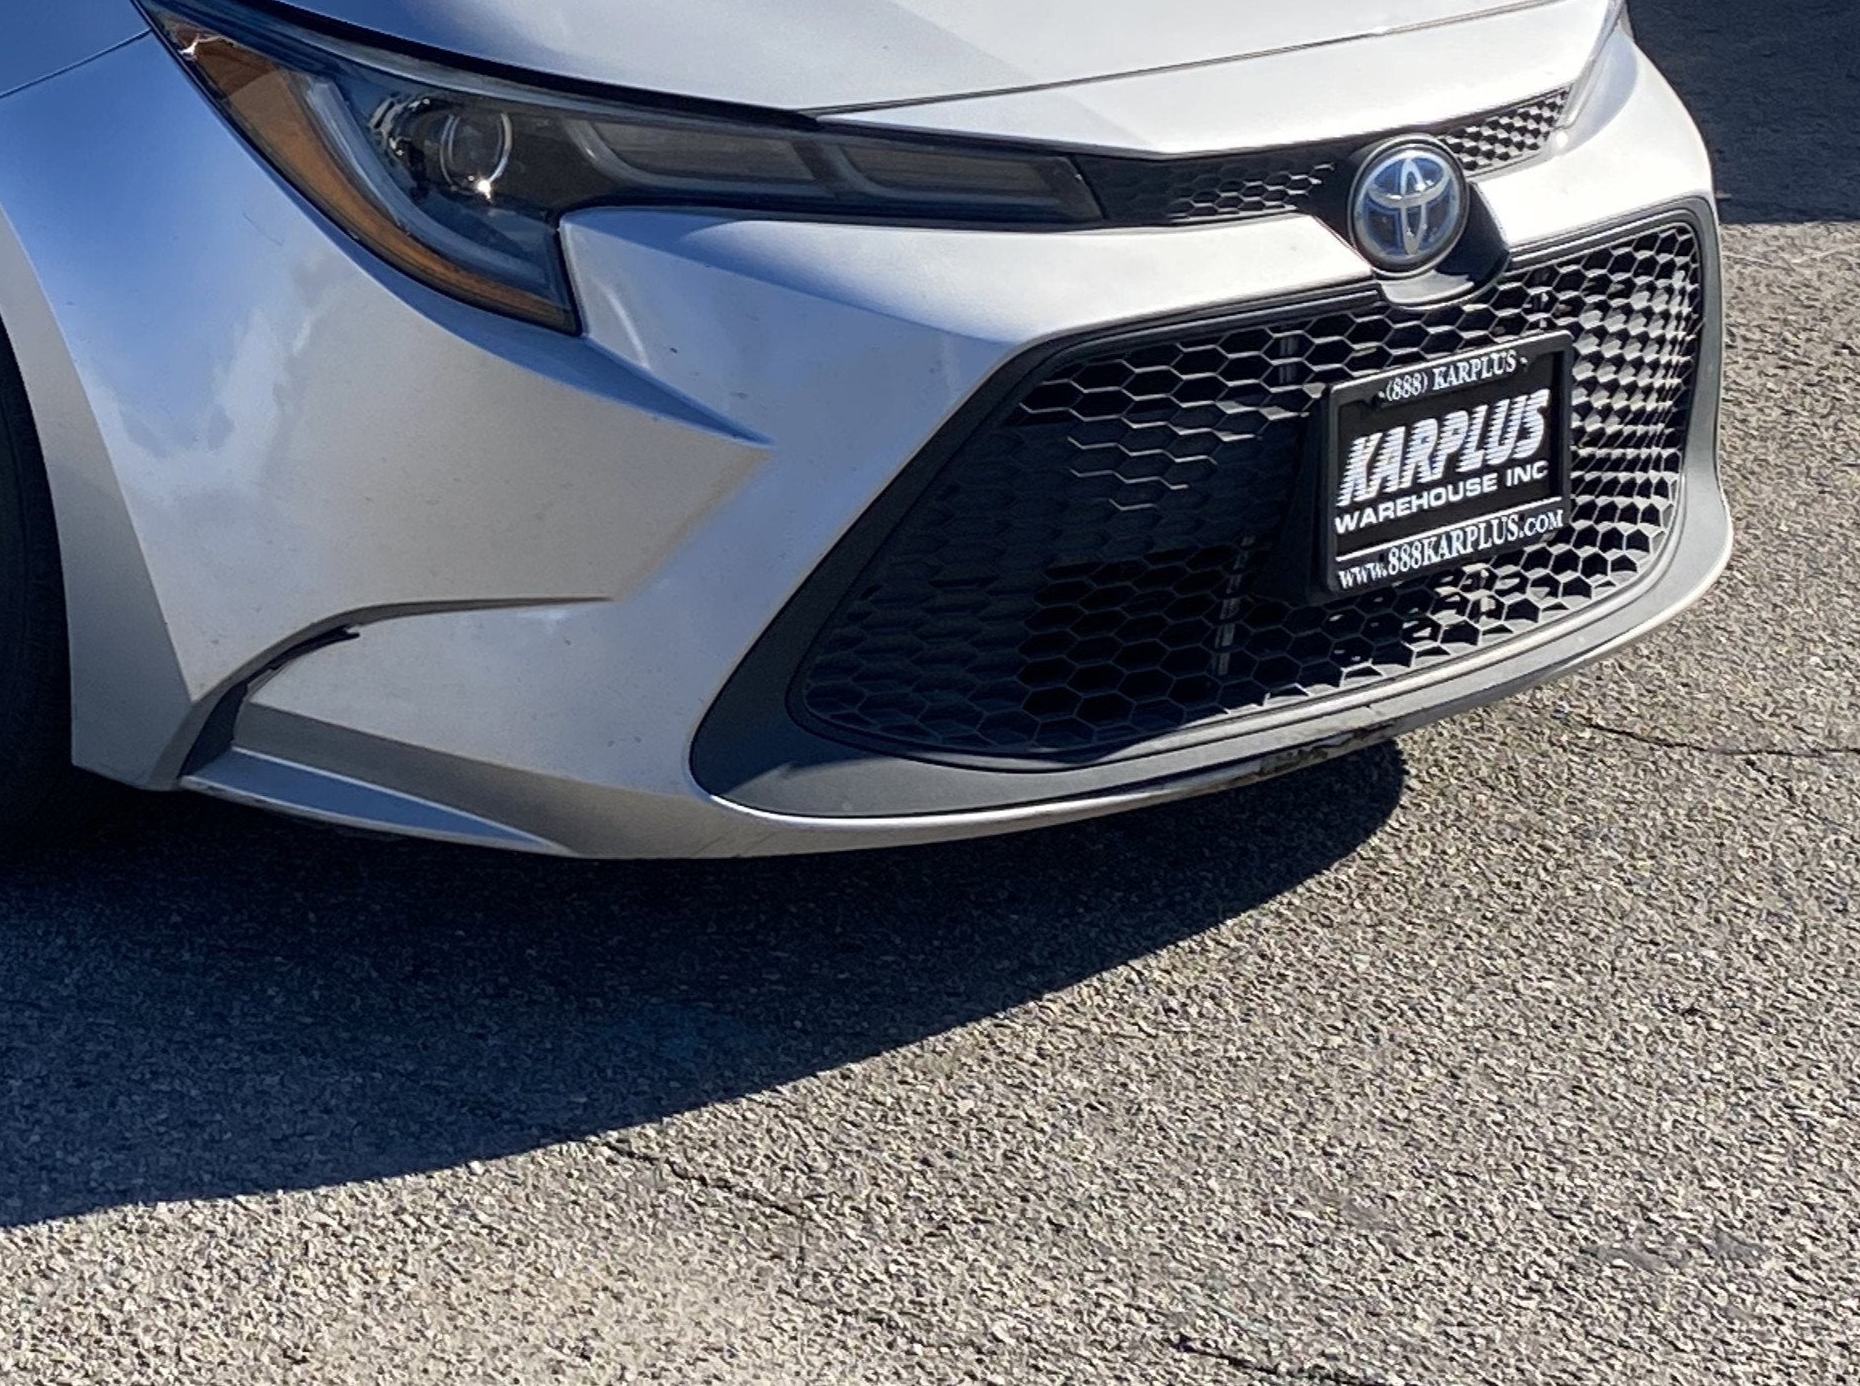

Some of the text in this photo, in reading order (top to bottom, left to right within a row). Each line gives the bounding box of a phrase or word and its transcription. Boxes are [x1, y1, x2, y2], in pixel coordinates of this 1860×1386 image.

[1386, 349, 1518, 402] (888) KARPLUS
[1336, 389, 1550, 507] KARPLUS
[1334, 460, 1549, 534] WAREHOUSE INC
